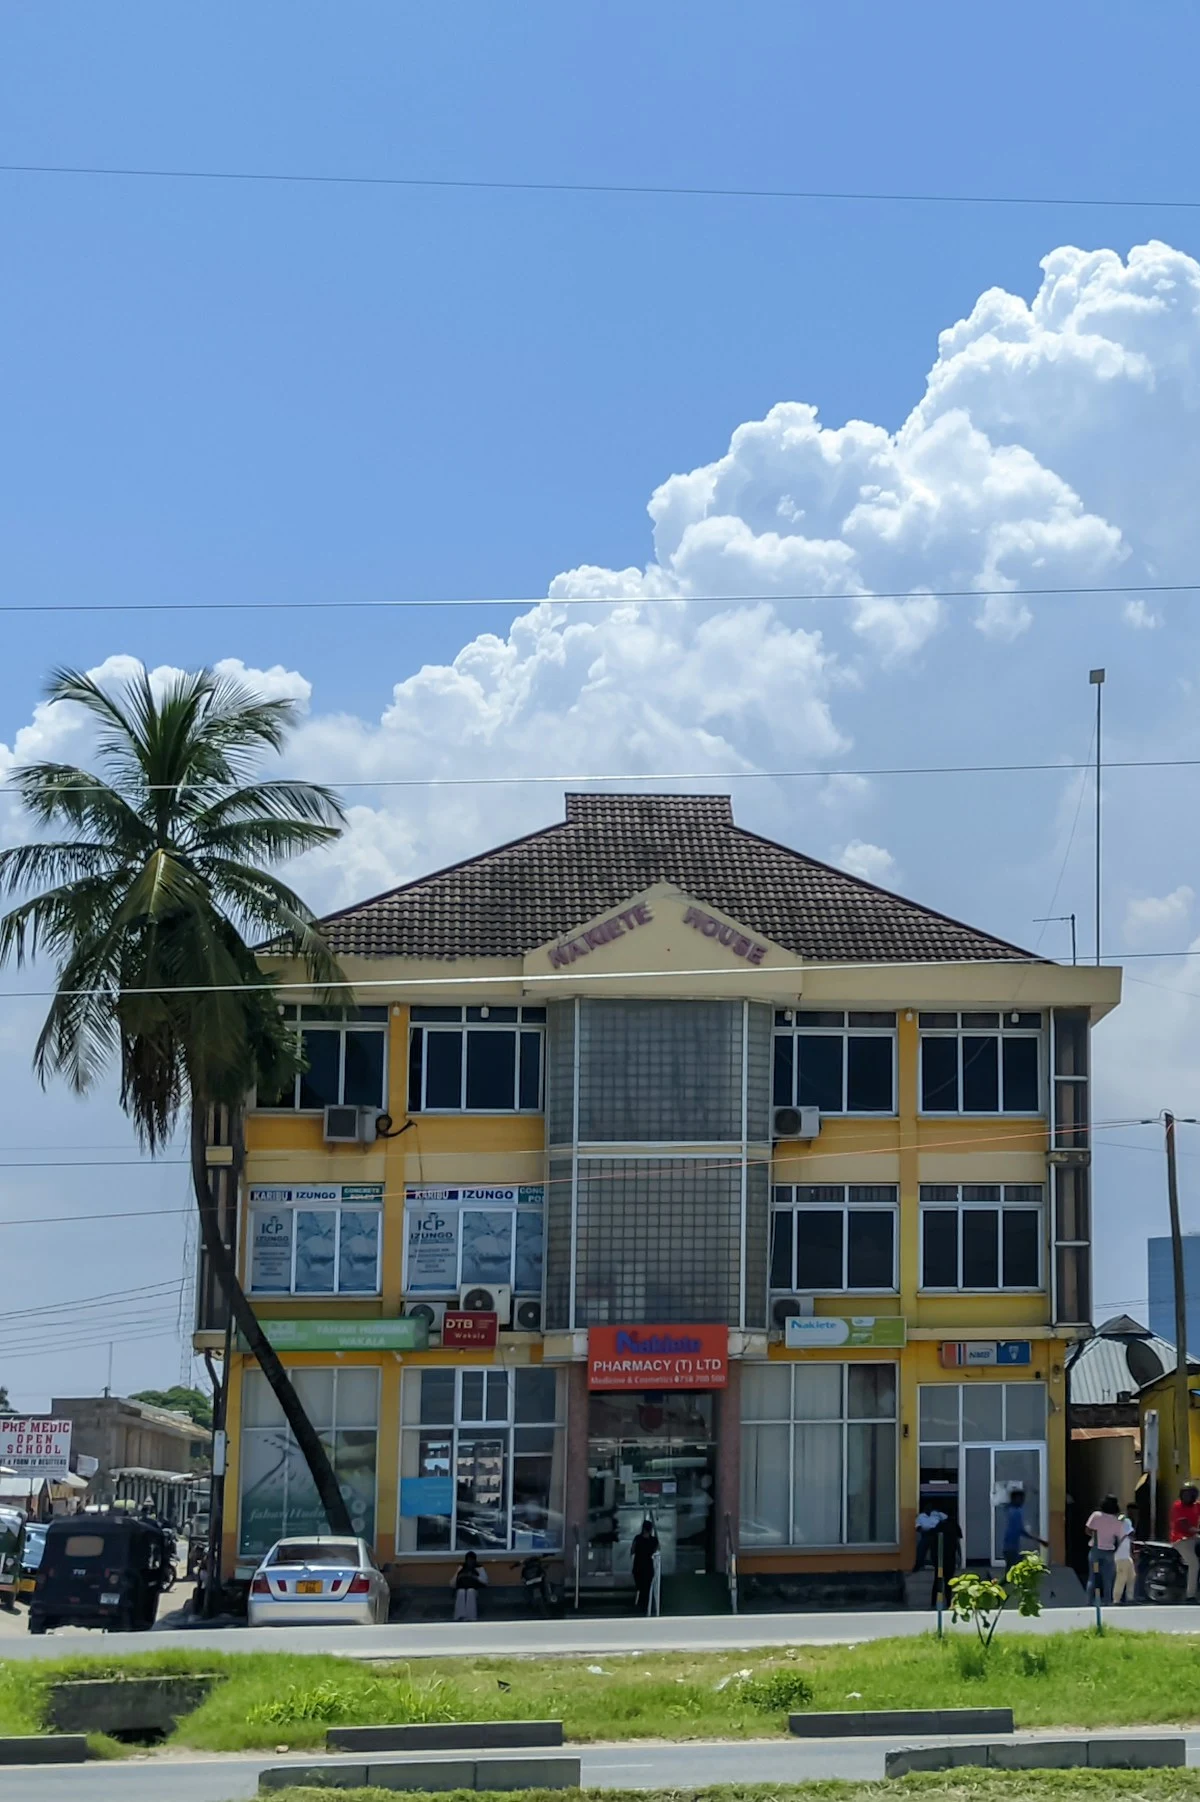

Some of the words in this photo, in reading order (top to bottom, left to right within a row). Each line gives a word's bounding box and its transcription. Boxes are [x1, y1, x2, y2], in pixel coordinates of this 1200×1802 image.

[683, 906, 768, 965] HOUSE
[253, 1191, 289, 1200] KARIBU
[296, 1191, 336, 1199] IZUNGO
[415, 1189, 449, 1199] KARIBU
[462, 1190, 514, 1199] IZUNGO
[261, 1223, 283, 1234] ICP
[418, 1220, 445, 1231] ICP
[446, 1319, 473, 1329] DTB
[791, 1319, 836, 1329] Nakiete
[339, 1336, 386, 1346] WAKALA
[593, 1360, 671, 1372] PHARMACY
[675, 1360, 692, 1373] (T)
[696, 1359, 721, 1370] LTD
[30, 1422, 70, 1433] MEDIC
[17, 1434, 53, 1444] OPEN
[7, 1444, 61, 1454] SCHOOL
